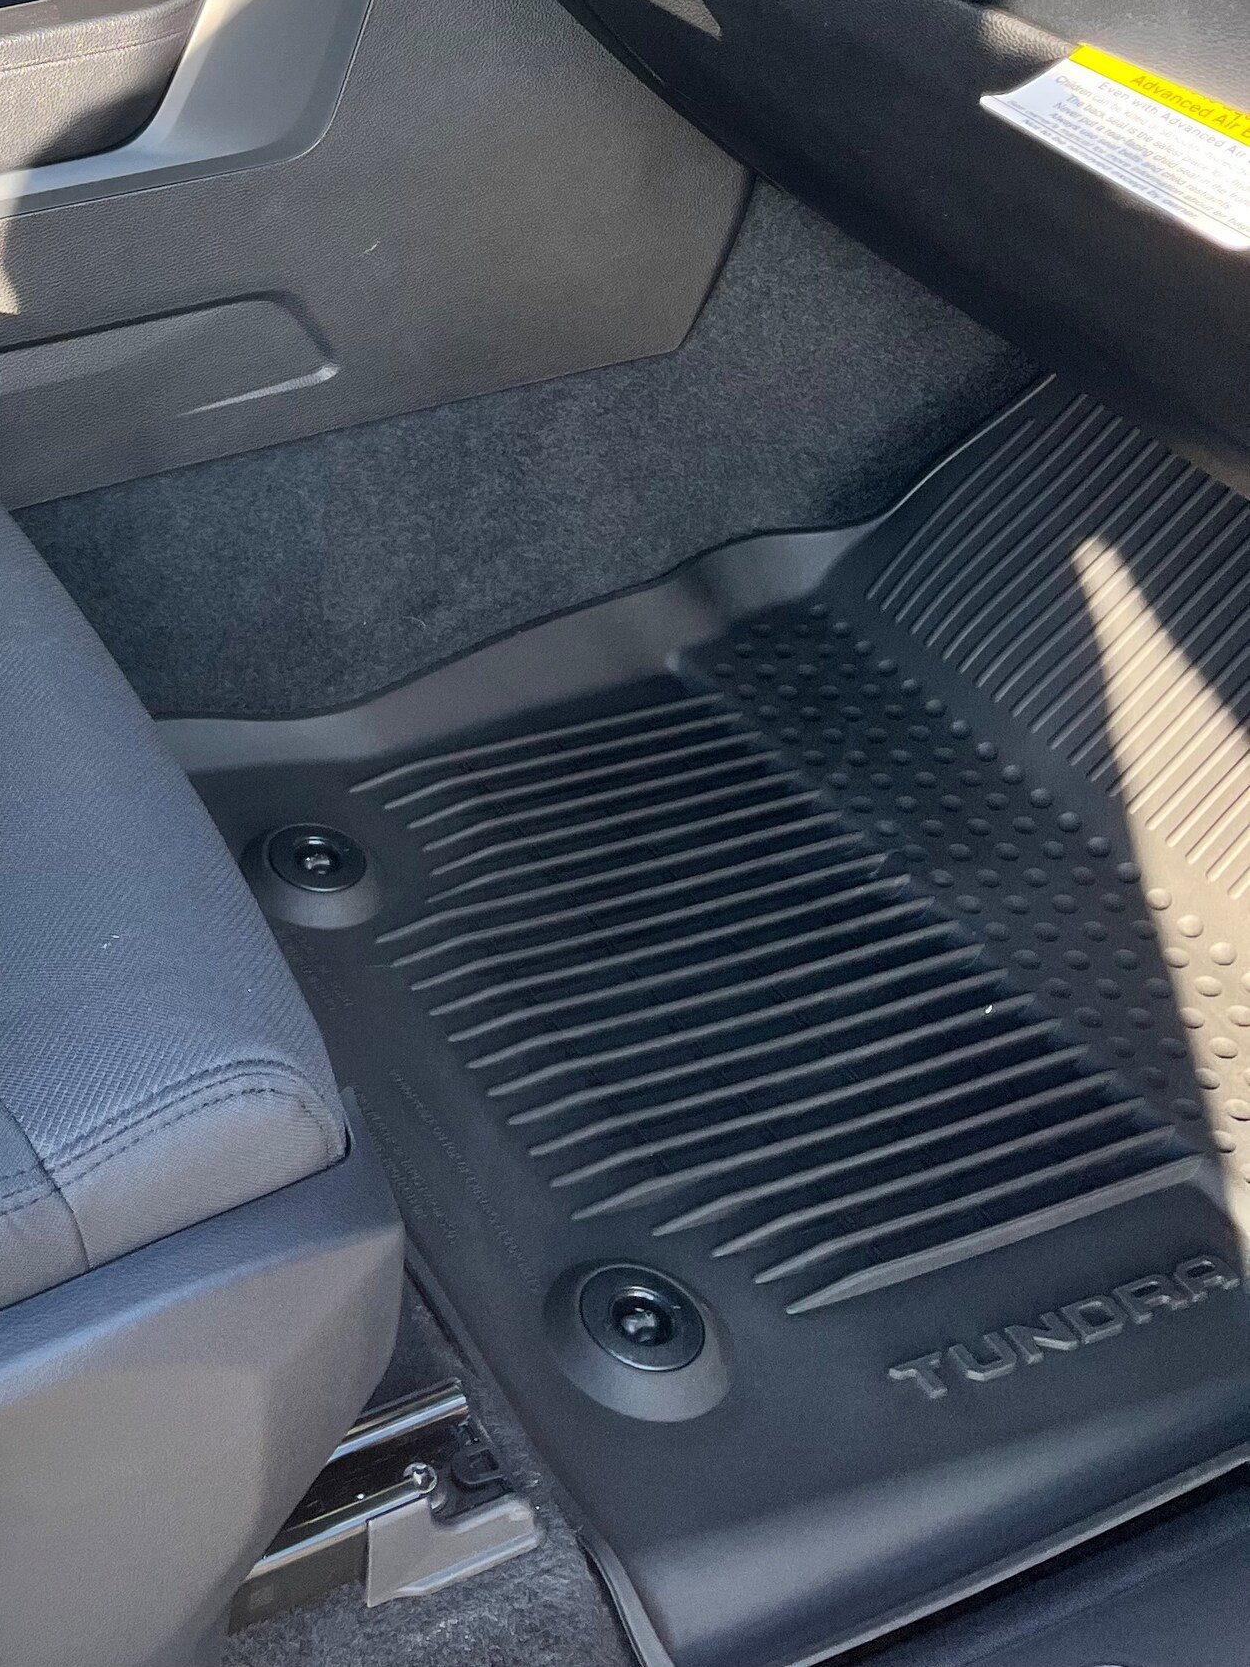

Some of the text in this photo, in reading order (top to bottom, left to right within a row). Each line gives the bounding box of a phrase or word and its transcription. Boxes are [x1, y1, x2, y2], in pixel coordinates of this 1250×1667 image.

[1054, 74, 1095, 98] Children
[1131, 73, 1212, 118] Advanced
[1053, 101, 1083, 118] Never
[1159, 111, 1226, 148] Advanced
[887, 1255, 1241, 1399] TUNDRA
